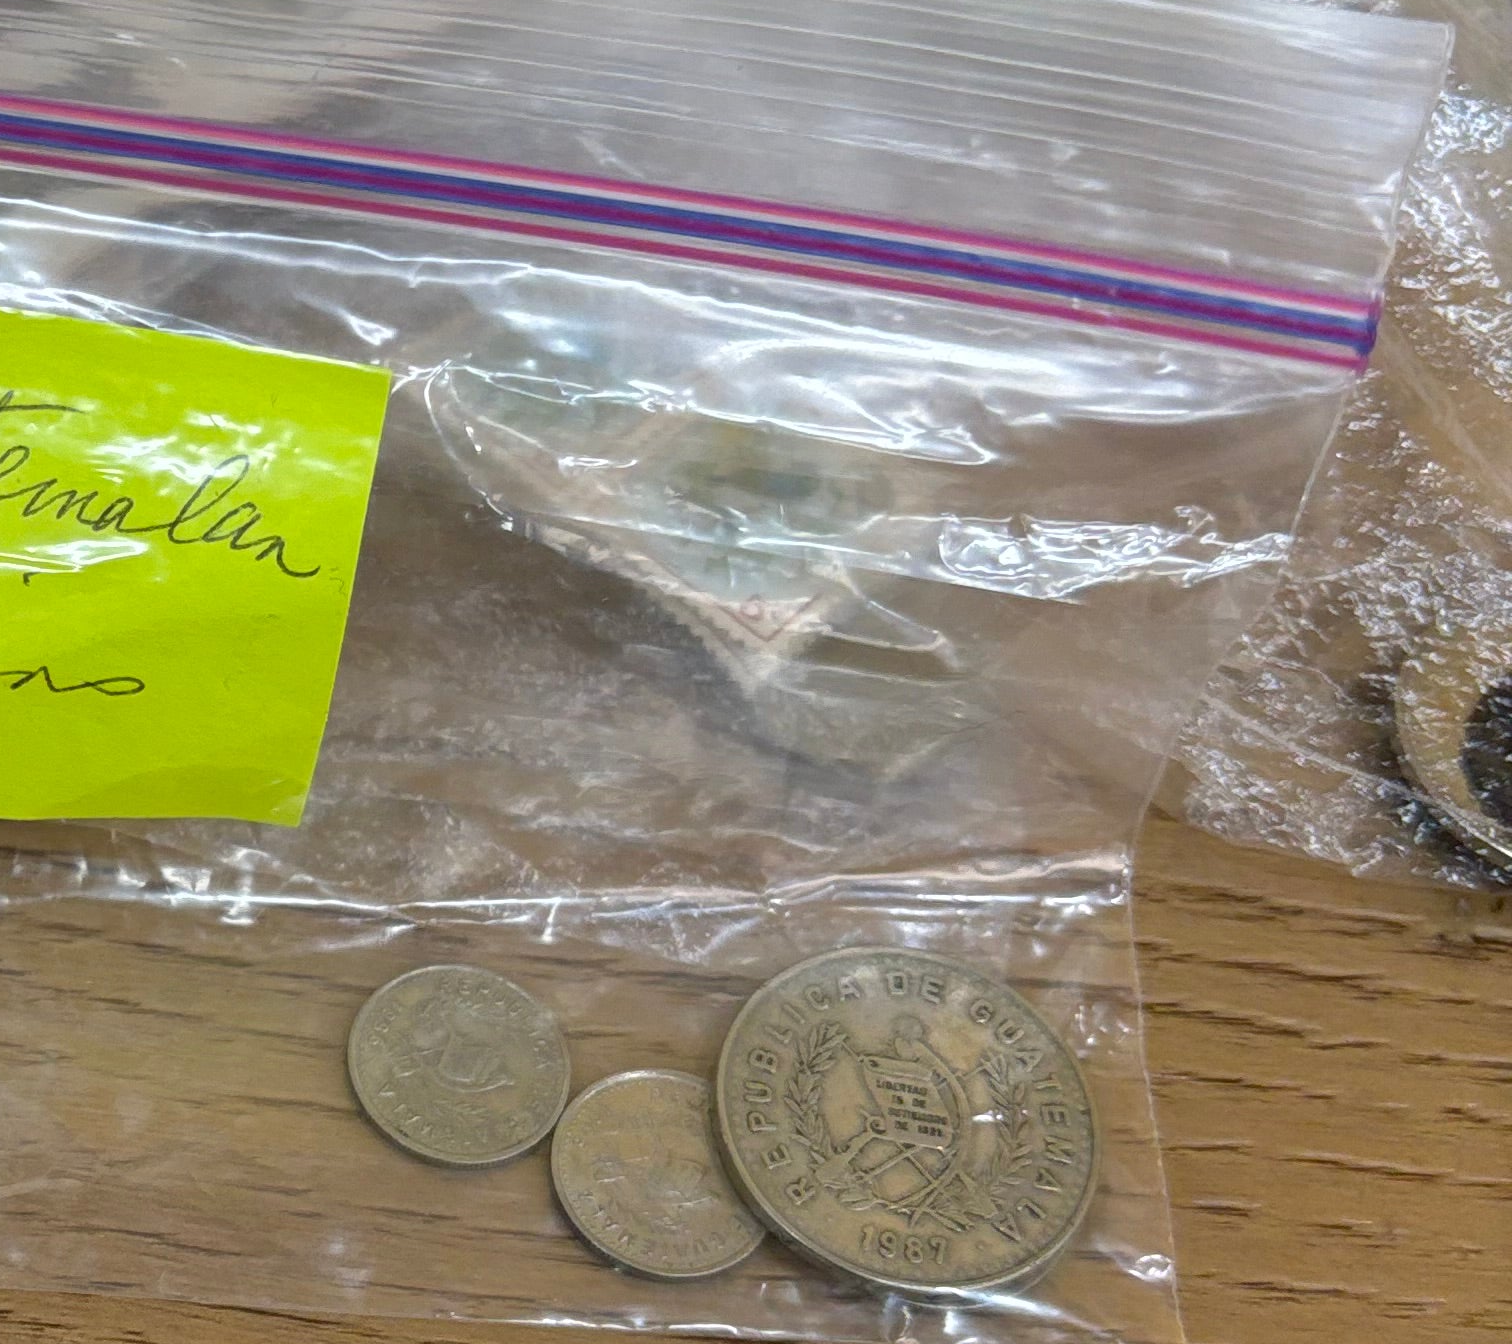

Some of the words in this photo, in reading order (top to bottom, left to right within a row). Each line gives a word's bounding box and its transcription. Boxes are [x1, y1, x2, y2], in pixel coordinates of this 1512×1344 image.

[743, 974, 861, 1206] REPUBLICA
[887, 971, 946, 1005] DE
[969, 999, 1073, 1244] GUATEMALA
[858, 1224, 949, 1265] 1987
